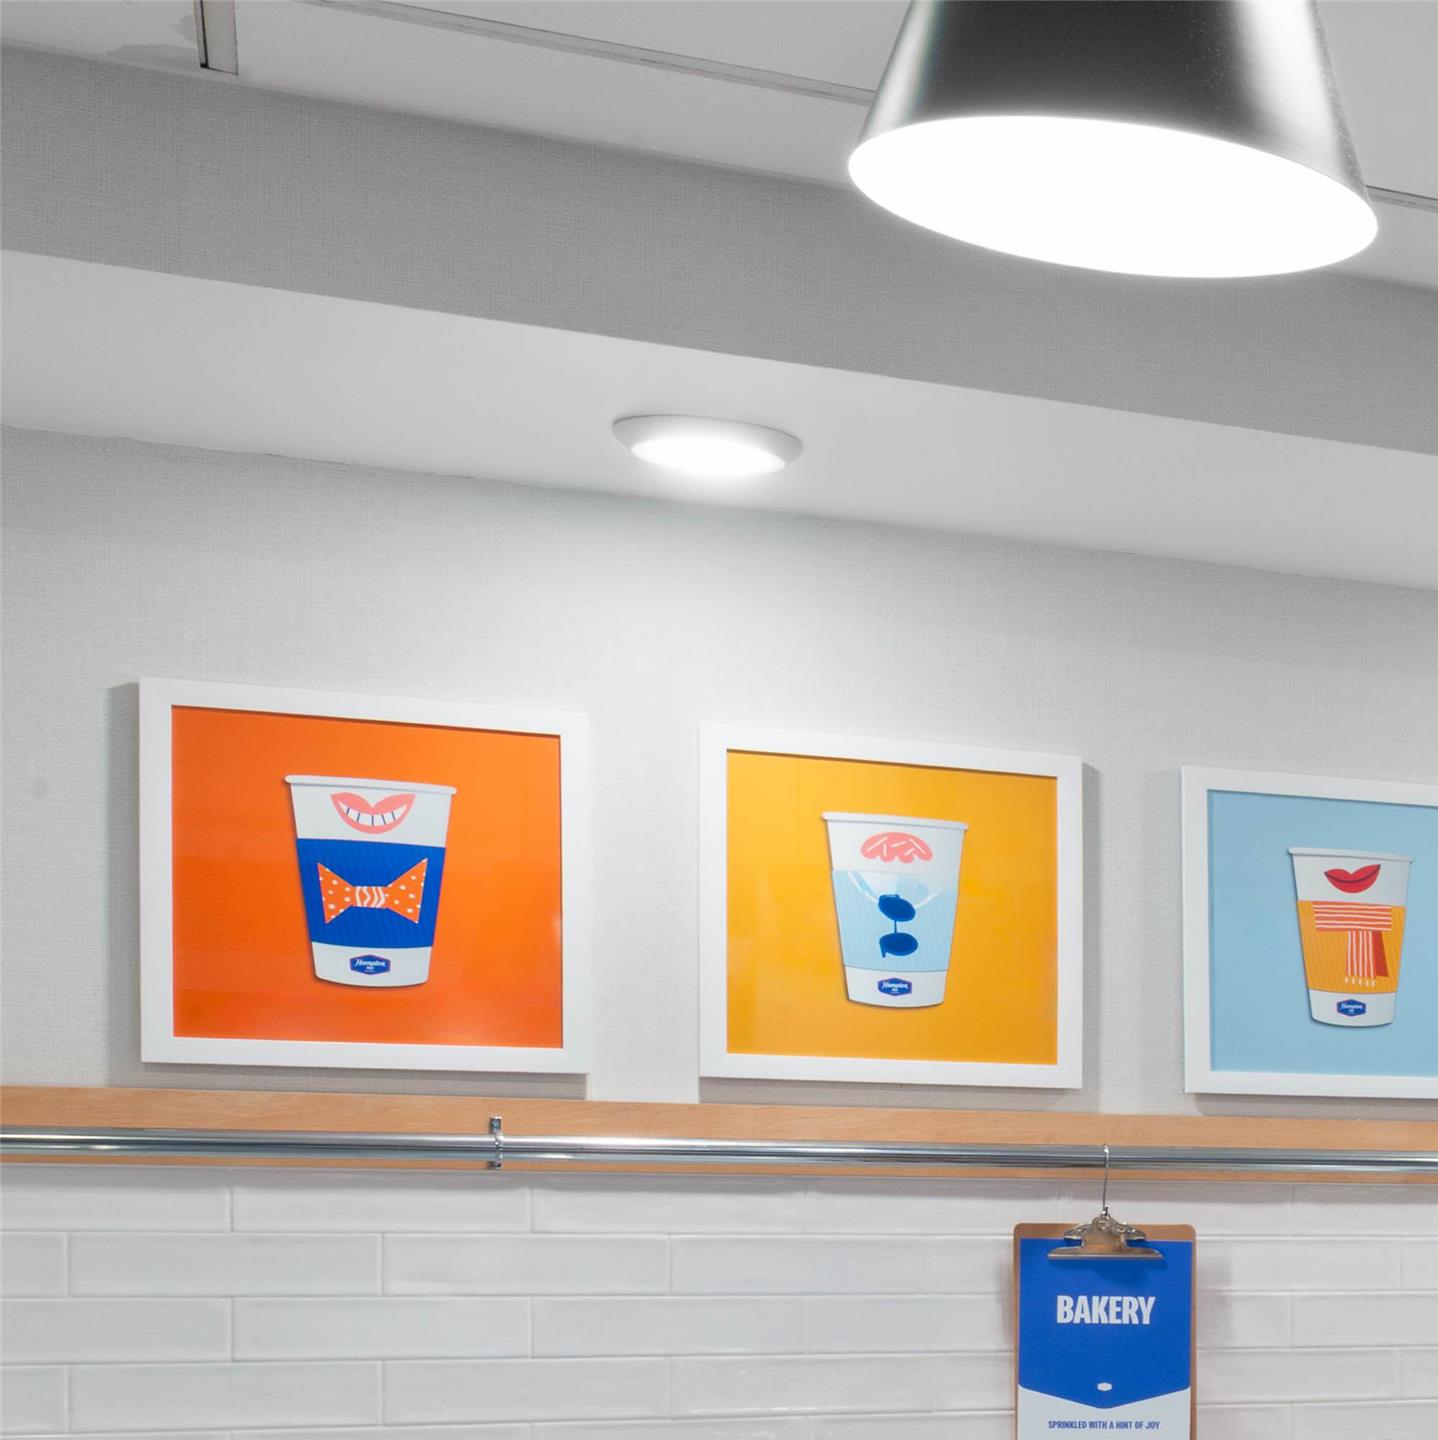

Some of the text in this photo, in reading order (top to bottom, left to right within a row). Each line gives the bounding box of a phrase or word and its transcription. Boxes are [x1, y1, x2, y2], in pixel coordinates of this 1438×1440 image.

[1056, 1295, 1156, 1325] BAKERY
[1048, 1420, 1160, 1429] SPRINKLED WITH A HINT OF JOY
